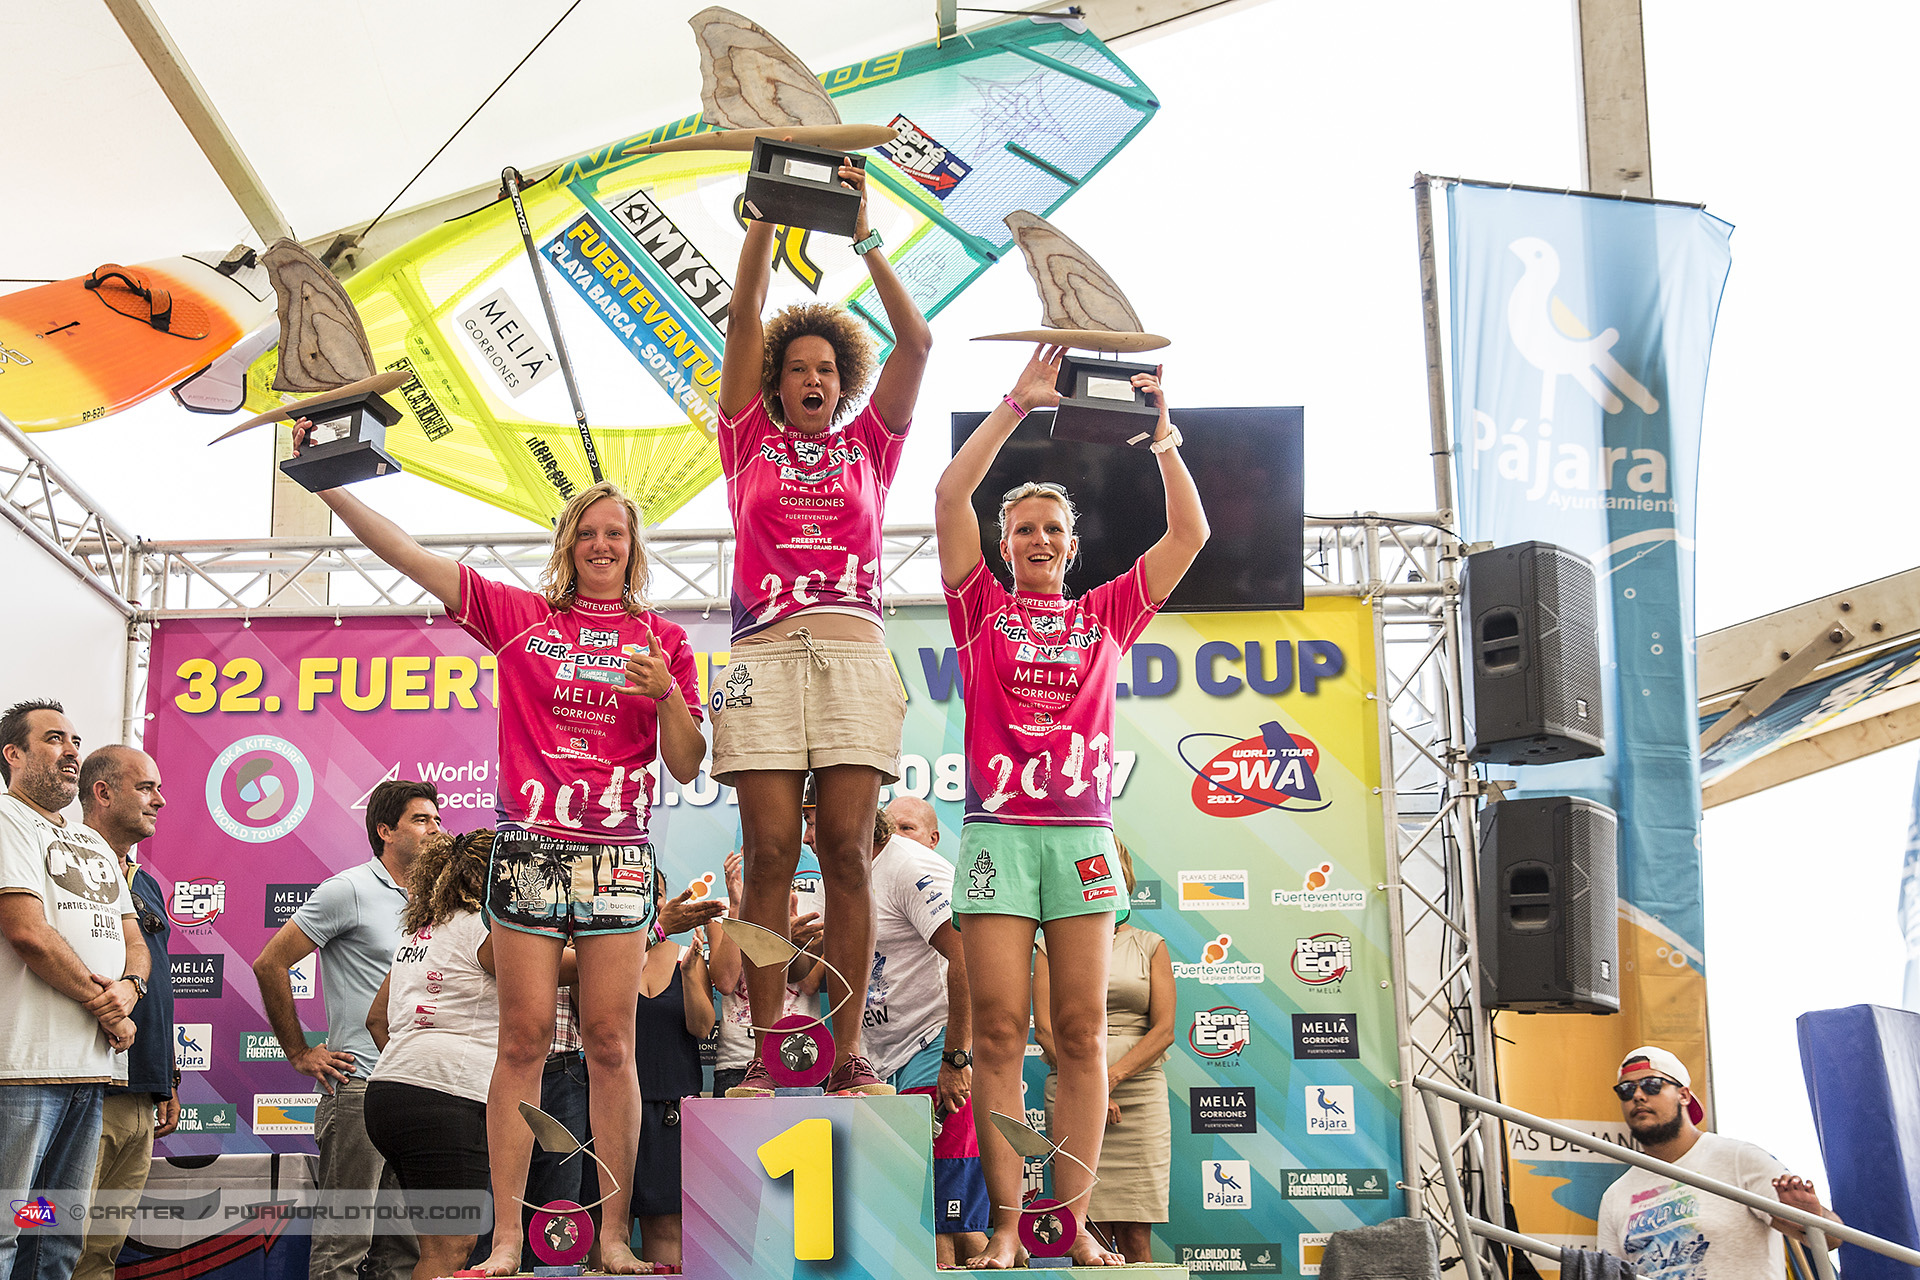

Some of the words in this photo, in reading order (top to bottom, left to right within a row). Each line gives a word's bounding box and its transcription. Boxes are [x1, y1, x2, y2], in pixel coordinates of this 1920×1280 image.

[549, 241, 594, 290] PLAYA
[587, 284, 637, 339] BARCA
[464, 319, 519, 389] GORRIONES
[82, 406, 105, 422] RP-620
[1472, 408, 1667, 501] Pájara
[780, 497, 844, 507] GORRIONES
[785, 513, 839, 521] FUERTEVENTURA
[580, 627, 619, 639] René
[175, 658, 280, 713] 32.
[1195, 640, 1343, 696] CUP
[552, 706, 616, 725] GORRIONES
[556, 724, 606, 737] FUERTEVENTURA
[220, 745, 244, 766] GKA
[245, 738, 303, 765] KITE-SURF
[1232, 749, 1276, 758] WORLD
[1280, 748, 1314, 757] TOUR
[417, 760, 489, 782] World
[1208, 759, 1306, 791] PWA
[1207, 795, 1245, 803] 2017
[213, 806, 248, 838] WORLD
[251, 826, 284, 840] TOUR
[284, 804, 305, 830] 2017
[565, 844, 589, 852] SURFING
[175, 881, 226, 895] René
[1274, 891, 1363, 903] Fuerteventura
[57, 902, 87, 911] PARTIES
[174, 895, 225, 918] Egli
[610, 903, 635, 911] bucket
[94, 913, 115, 930] CLUB
[1296, 937, 1351, 952] René
[1173, 964, 1260, 976] Fuerteventura
[1297, 952, 1352, 977] Egli
[1209, 974, 1226, 983] playa
[1195, 1010, 1250, 1025] René
[1196, 1025, 1250, 1050] Egli
[176, 1055, 204, 1067] ájara
[187, 1109, 198, 1119] DE
[1311, 1118, 1347, 1130] Pájara
[1299, 1173, 1336, 1184] CABILDO
[1337, 1174, 1348, 1185] DE
[756, 1118, 833, 1260] 1
[1288, 1185, 1354, 1196] FUERTEVENTURA
[1207, 1192, 1244, 1206] Pájara
[1194, 1248, 1230, 1259] CABILDO
[1231, 1248, 1241, 1259] DE
